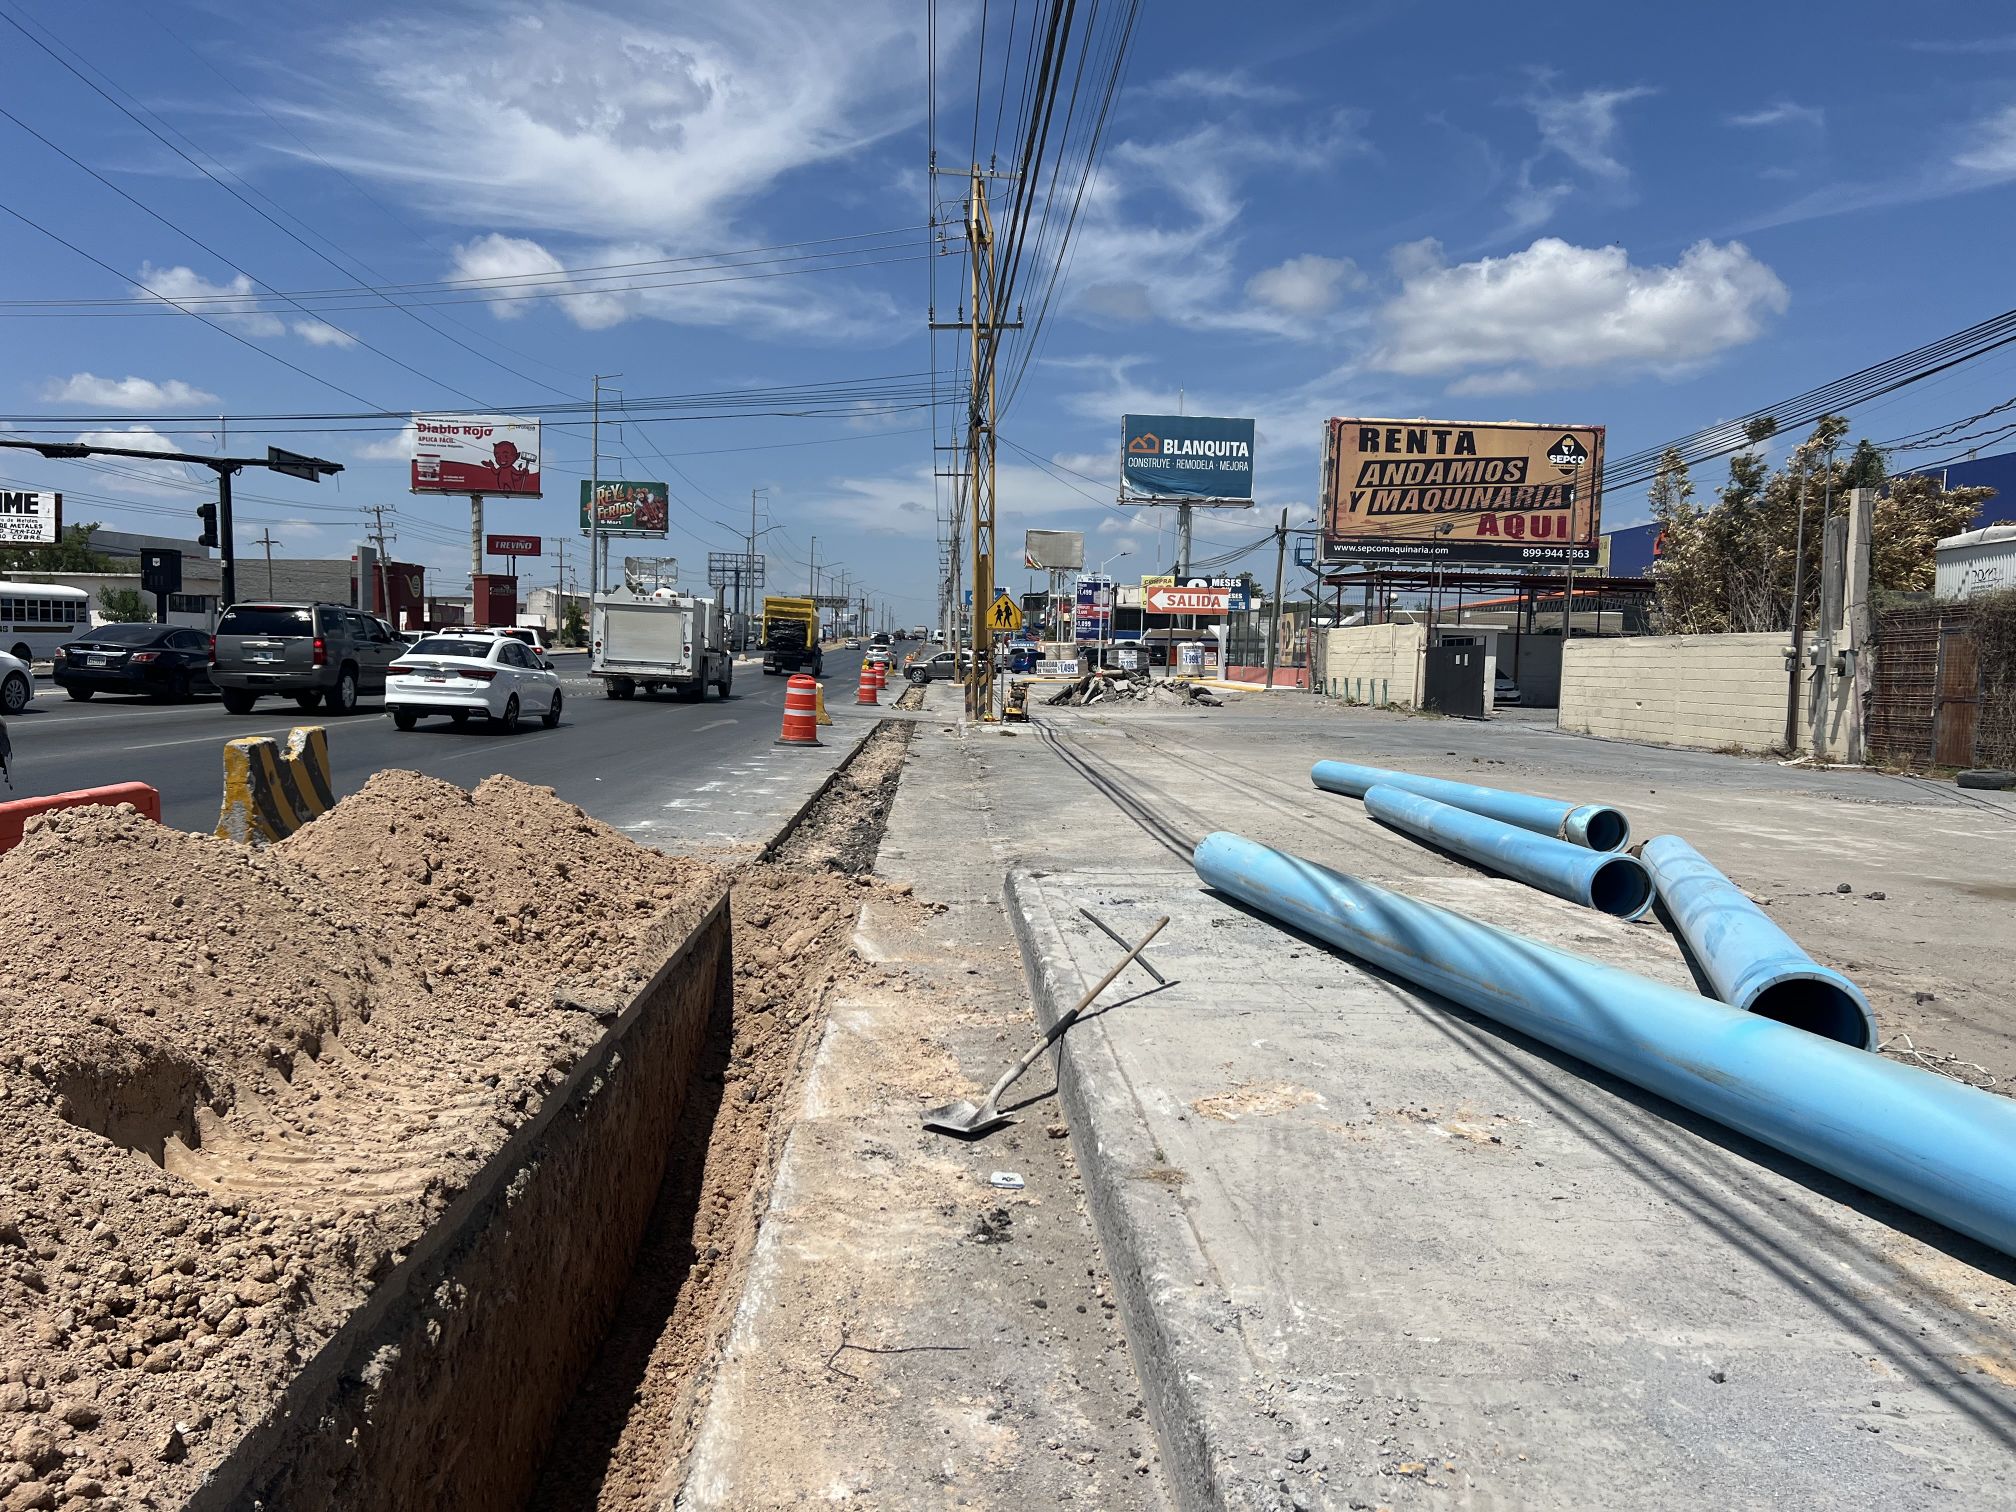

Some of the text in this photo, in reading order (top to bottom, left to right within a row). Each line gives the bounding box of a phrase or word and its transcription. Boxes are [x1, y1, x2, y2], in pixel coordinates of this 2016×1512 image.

[416, 422, 493, 439] Diablo Rojo
[1163, 439, 1249, 457] BLANQUITA
[1358, 428, 1477, 455] RENTA
[1128, 457, 1249, 471] CONSTRUYE REMODELA MEJORA
[1550, 454, 1586, 464] SEPCO
[1361, 460, 1524, 486] ANDAMIOS
[597, 484, 621, 505] REY
[1348, 485, 1565, 513] Y MAQUINARIA
[597, 501, 634, 519] FERTAS
[1476, 513, 1567, 539] AQUI
[1522, 548, 1590, 558] 899-944 3863
[1211, 578, 1242, 587] MESES
[1167, 594, 1221, 608] SALIDA
